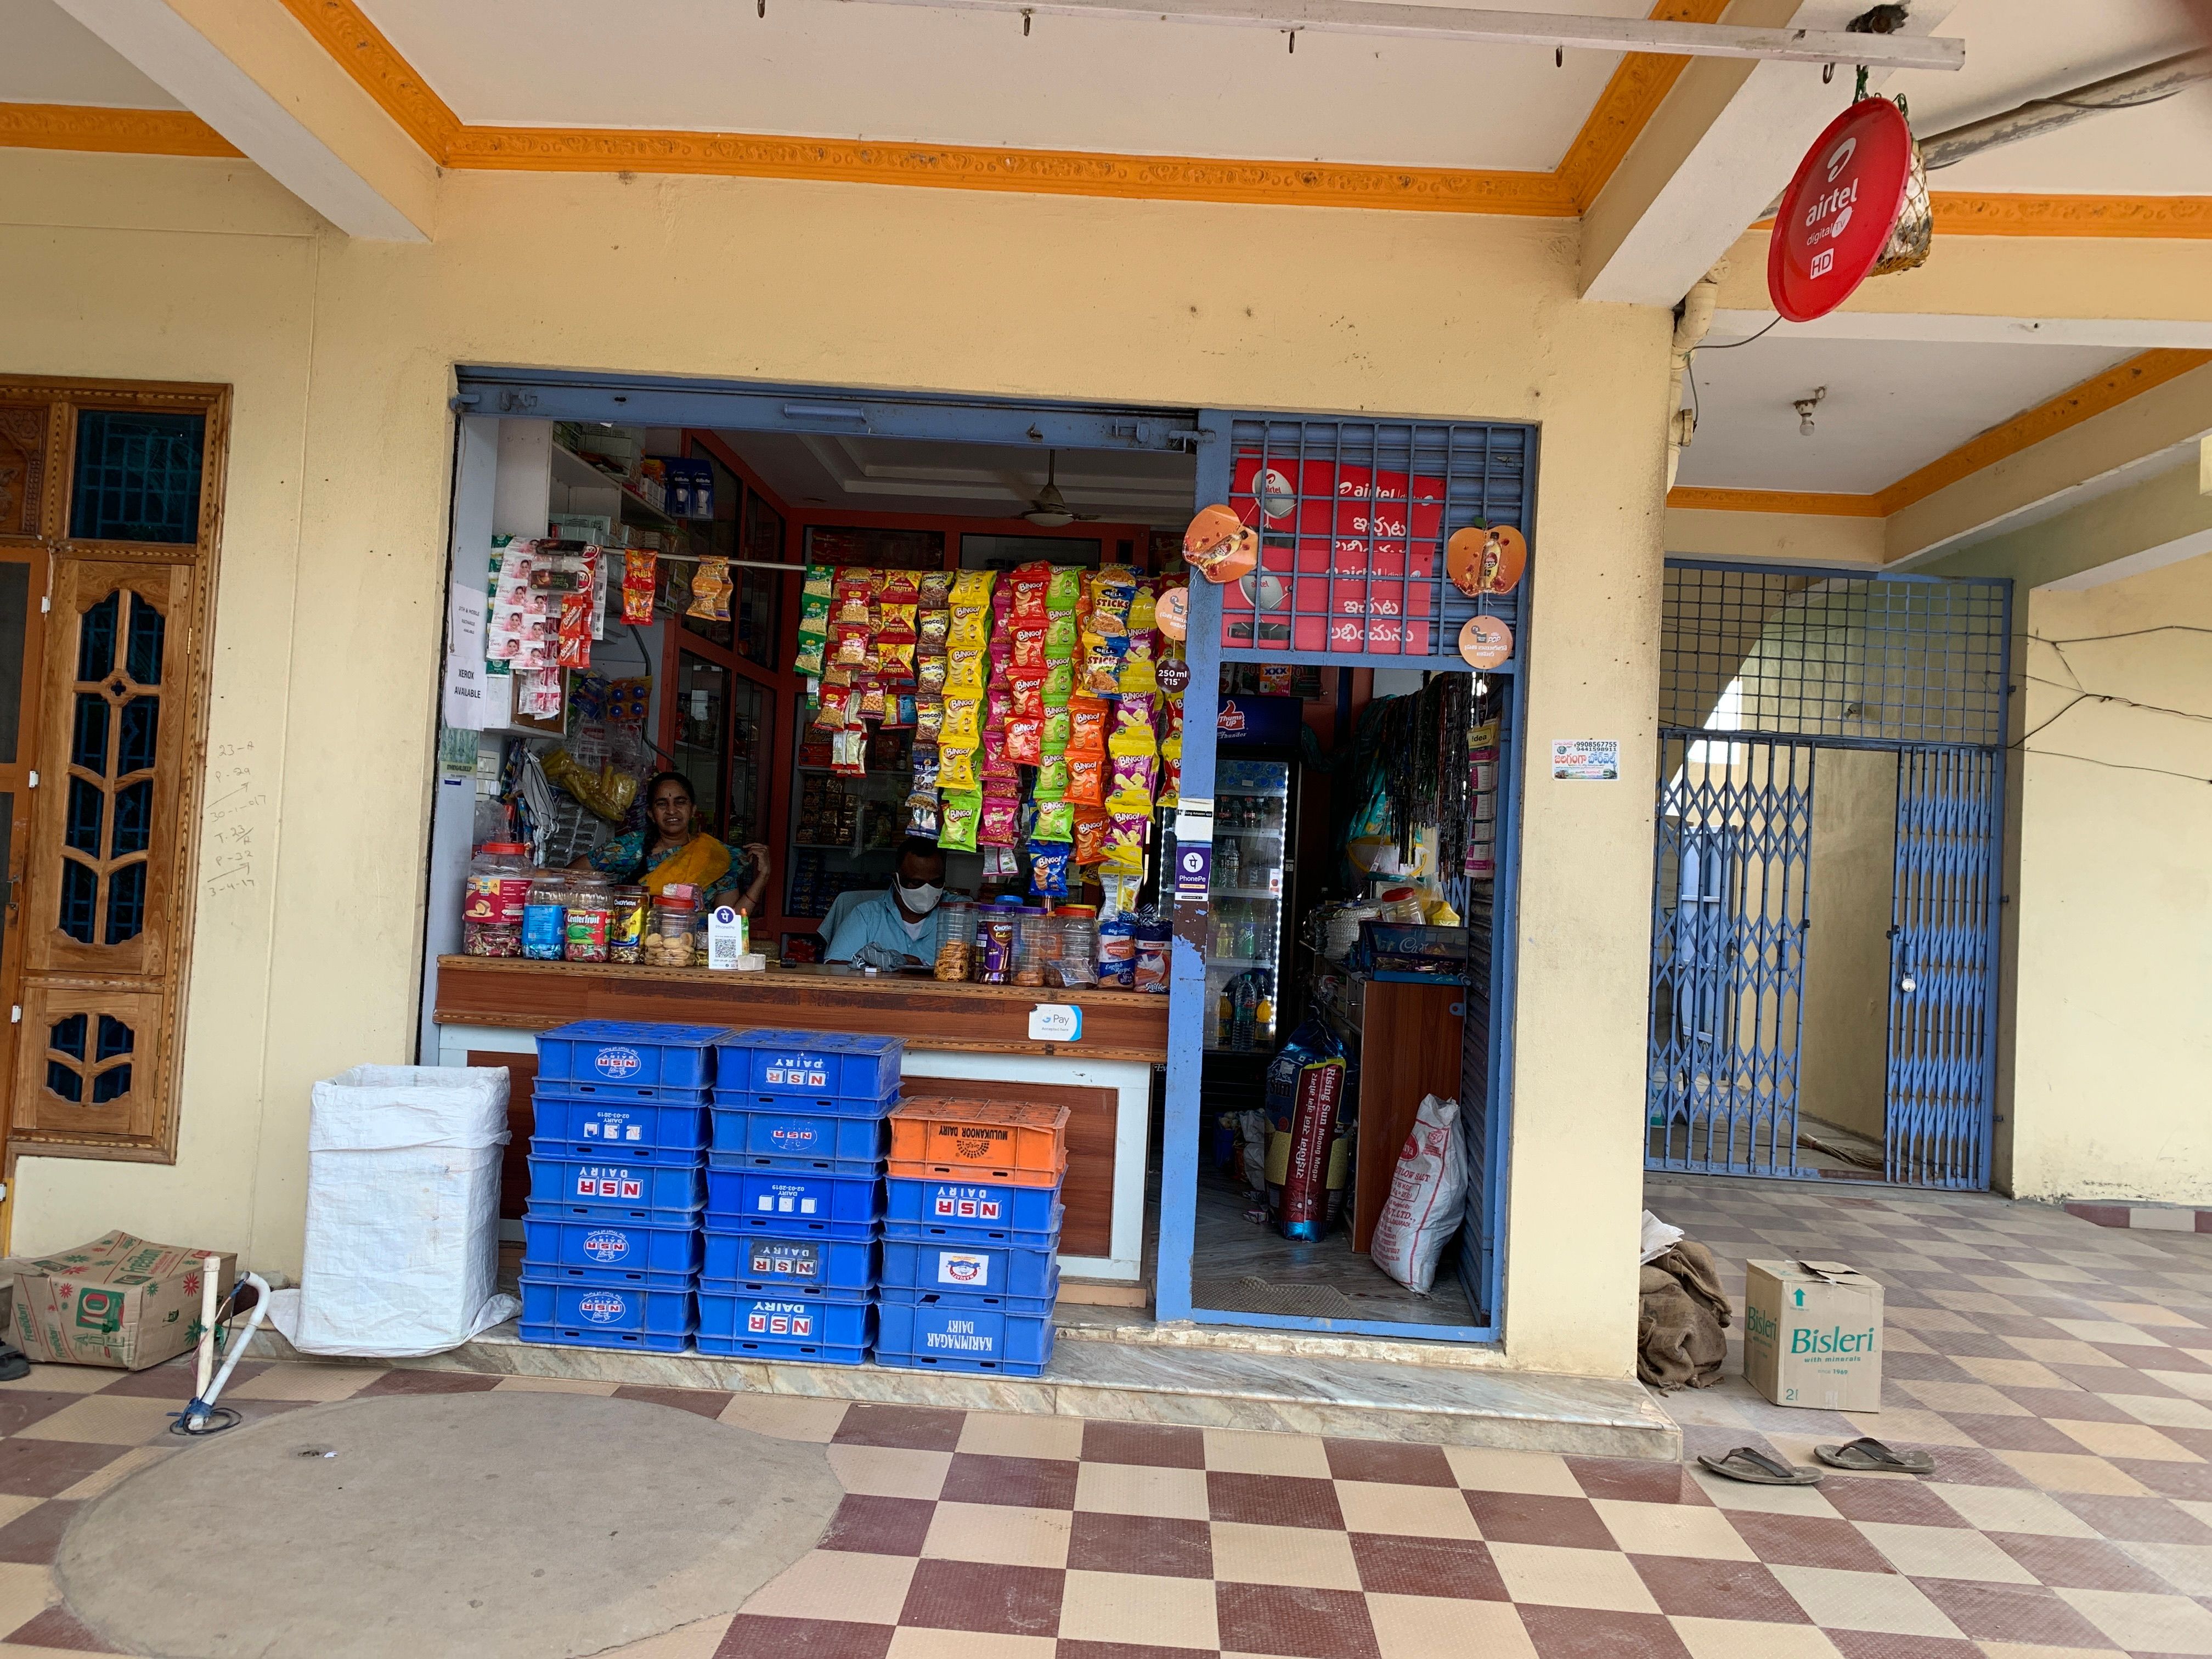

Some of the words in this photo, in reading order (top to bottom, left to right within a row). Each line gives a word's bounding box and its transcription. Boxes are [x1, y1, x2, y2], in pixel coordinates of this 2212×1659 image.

[1806, 178, 1858, 226] airtel
[1807, 226, 1832, 245] digital
[1834, 218, 1847, 233] TV
[1812, 253, 1832, 275] HD
[1019, 582, 1043, 591] BINGO!
[1096, 599, 1130, 610] STICKS
[957, 606, 980, 616] BINGO!
[1049, 609, 1072, 620] BINGO!
[1018, 629, 1042, 641] BINGO!
[953, 651, 978, 660] BINGO!
[1047, 657, 1070, 669] BINGO!
[458, 669, 475, 680] XEROX
[1176, 669, 1187, 678] ml
[1016, 679, 1040, 691] BINGO!
[454, 686, 481, 698] AVAILABLE
[1122, 691, 1148, 702] BINGO!
[950, 699, 975, 709] BINGO!
[1076, 713, 1099, 723] BINGO!
[1219, 715, 1243, 723] Thums
[1013, 722, 1037, 732] BINGO!
[945, 747, 970, 757] BINGO!
[1074, 761, 1097, 771] BINGO!
[1119, 754, 1145, 766] BINGO!
[1042, 802, 1066, 811] BINGO!
[950, 809, 973, 821] BINGO!
[1115, 812, 1141, 822] BINGO!
[1079, 821, 1103, 833] BINGO!
[1036, 855, 1062, 868] BINGO!
[1053, 1014, 1069, 1026] Pay
[599, 1058, 636, 1068] NSR
[775, 1058, 822, 1069] DAIRY
[768, 1072, 823, 1085] NSR
[1321, 1068, 1336, 1102] Rising
[1320, 1104, 1330, 1125] Sun
[938, 1125, 958, 1137] DAIRY
[1302, 1116, 1312, 1135] सन
[774, 1131, 810, 1139] NSR
[961, 1127, 1008, 1141] MULUKANOOR
[1316, 1128, 1325, 1155] Moong
[579, 1166, 628, 1178] DAIRY
[1312, 1156, 1321, 1183] Mogar
[580, 1180, 639, 1195] NSR
[937, 1186, 987, 1198] DAIRY
[937, 1199, 998, 1218] NSR
[586, 1242, 624, 1251] NSR
[762, 1246, 809, 1257] DAIRY
[754, 1260, 810, 1273] NSR
[582, 1303, 621, 1312] NSR
[753, 1301, 805, 1314] DAIRY
[17, 1302, 35, 1342] Freedom
[750, 1316, 809, 1334] NSR
[946, 1319, 974, 1334] DAIRY
[1747, 1306, 1777, 1341] Bisleri
[927, 1332, 992, 1351] KARIMNAGAR
[1791, 1326, 1875, 1354] Bisleri
